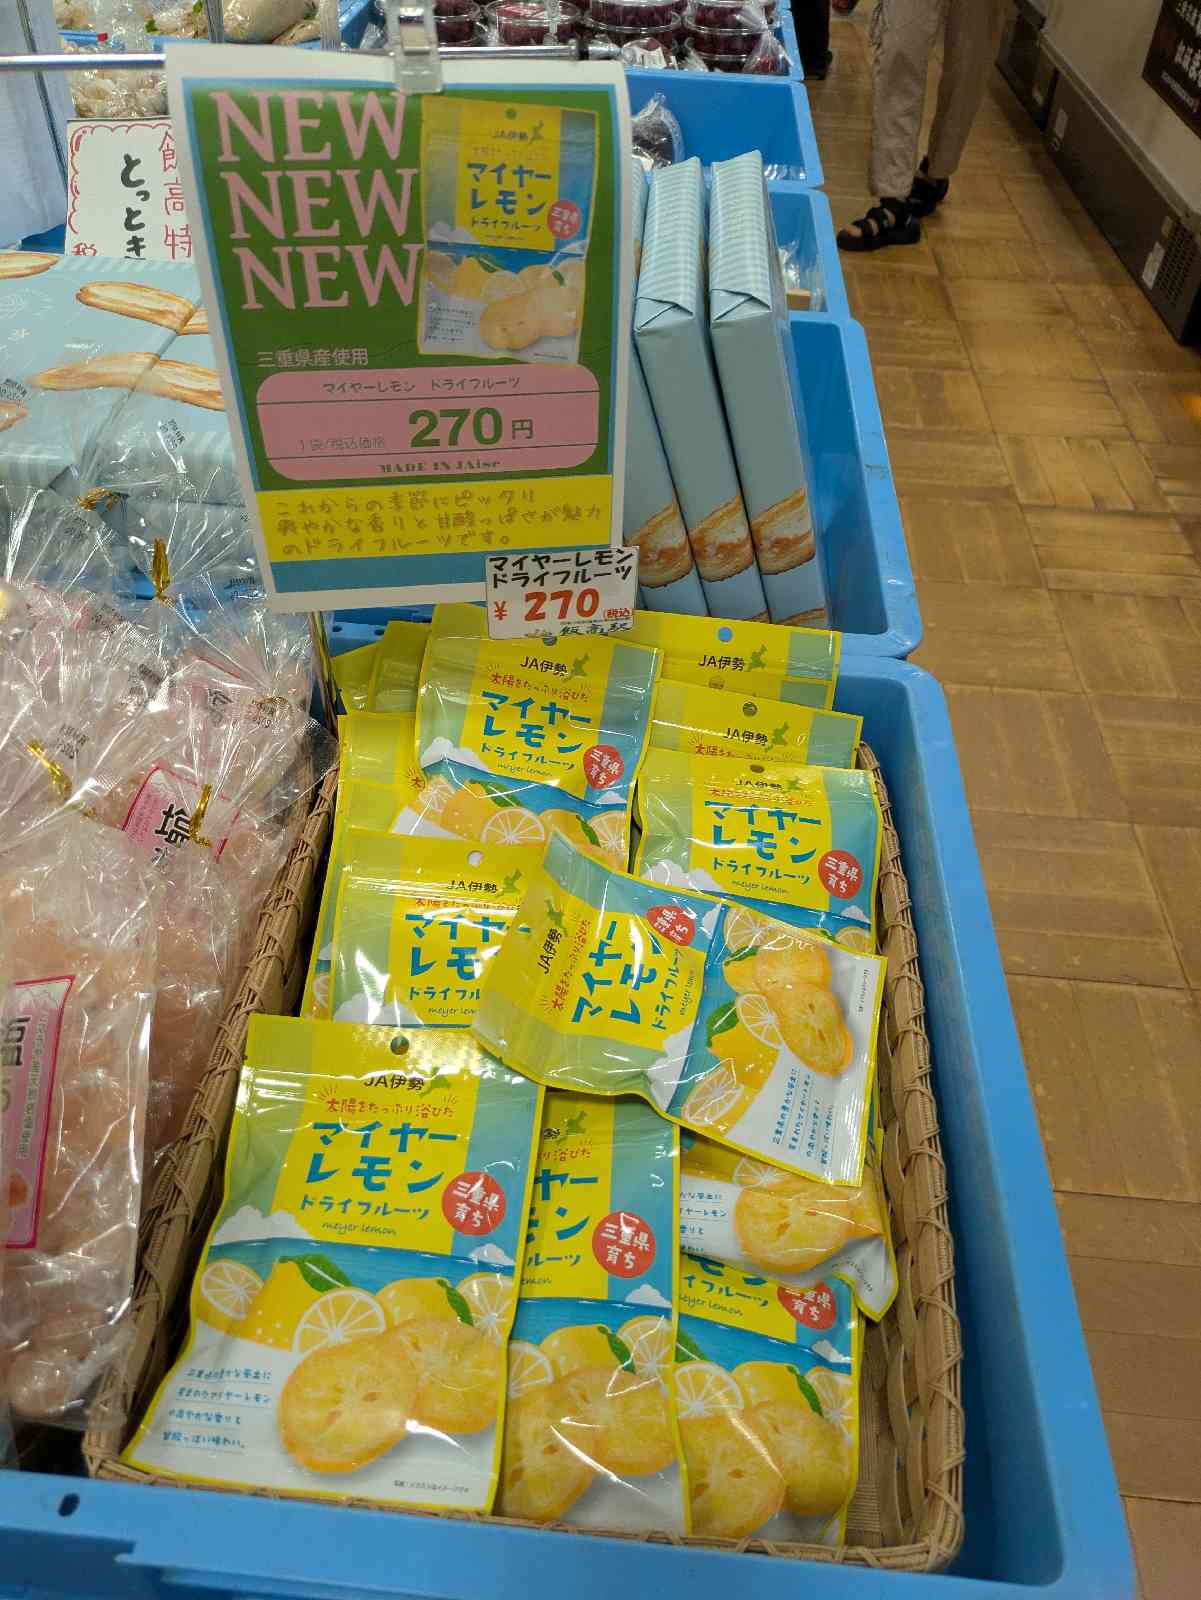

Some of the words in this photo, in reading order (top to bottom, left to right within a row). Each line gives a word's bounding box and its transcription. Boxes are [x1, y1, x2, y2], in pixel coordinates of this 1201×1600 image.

[208, 91, 407, 162] NEW
[466, 162, 552, 188] マイヤー
[219, 168, 418, 239] NEW
[471, 188, 546, 216] レモン
[232, 243, 424, 310] NEW
[256, 347, 369, 369] 三重県産使用
[322, 382, 416, 394] マイヤーレモン
[431, 376, 521, 392] ドライフルーツ
[408, 406, 504, 449] 270
[511, 418, 535, 440] 円
[489, 548, 633, 572] マイヤーレモン
[492, 565, 632, 589] ドライフルーツ
[524, 588, 600, 621] 270
[519, 656, 570, 677] JA伊勢
[698, 654, 746, 671] JA伊勢
[480, 690, 593, 726] マイヤー
[482, 715, 583, 754] レモン
[723, 727, 769, 747] JA伊勢
[704, 800, 823, 831] マイヤー
[712, 825, 818, 864] レモン
[537, 927, 563, 975] JA伊勢
[570, 919, 624, 1024] マイヤー
[363, 1074, 426, 1091] JA伊勢
[312, 1120, 459, 1153] マイヤー
[305, 1152, 446, 1194] レモン
[453, 1202, 485, 1228] 育ち
[600, 1222, 650, 1252] 三重県
[605, 1244, 637, 1270] 育ち
